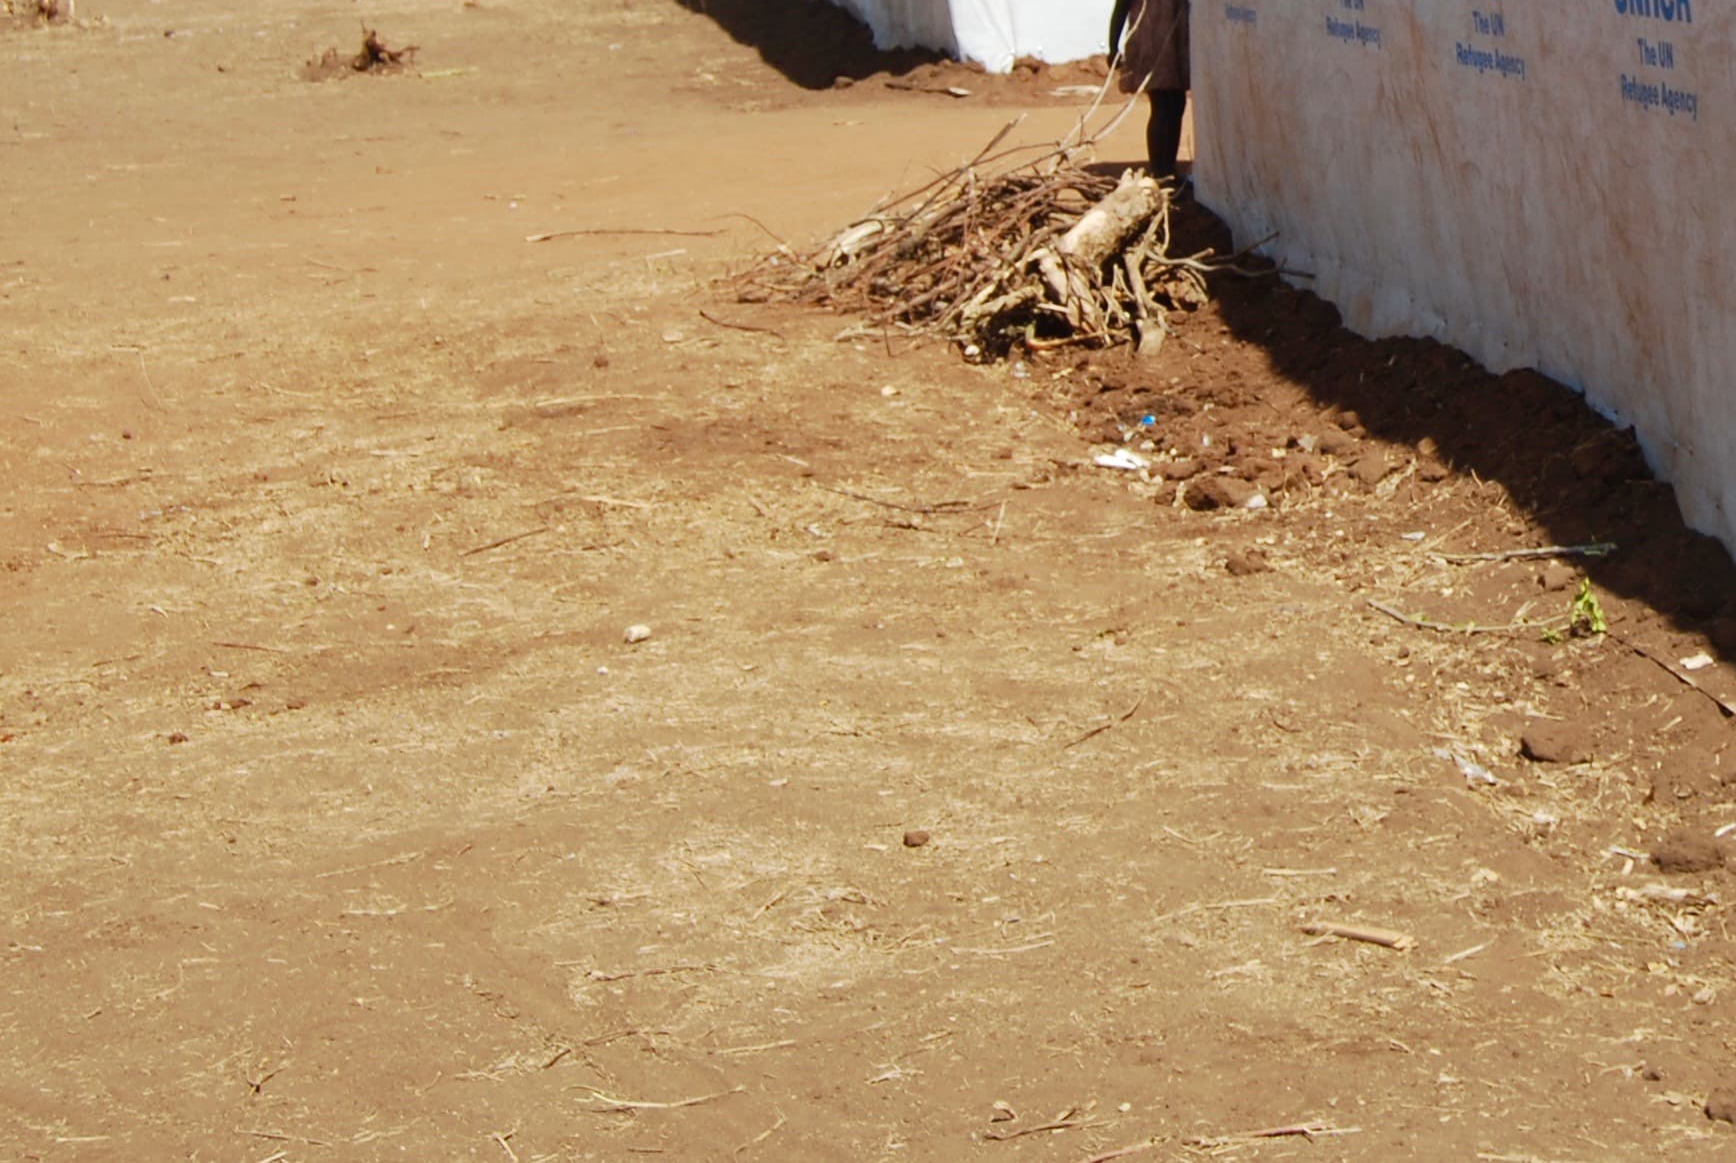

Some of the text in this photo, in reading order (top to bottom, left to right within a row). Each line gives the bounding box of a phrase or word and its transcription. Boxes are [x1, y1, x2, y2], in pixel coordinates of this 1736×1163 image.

[1472, 10, 1505, 36] The UN
[1456, 42, 1526, 80] Refugee Agency
[1637, 39, 1675, 70] The UN
[1620, 74, 1698, 120] Refugee Agency
